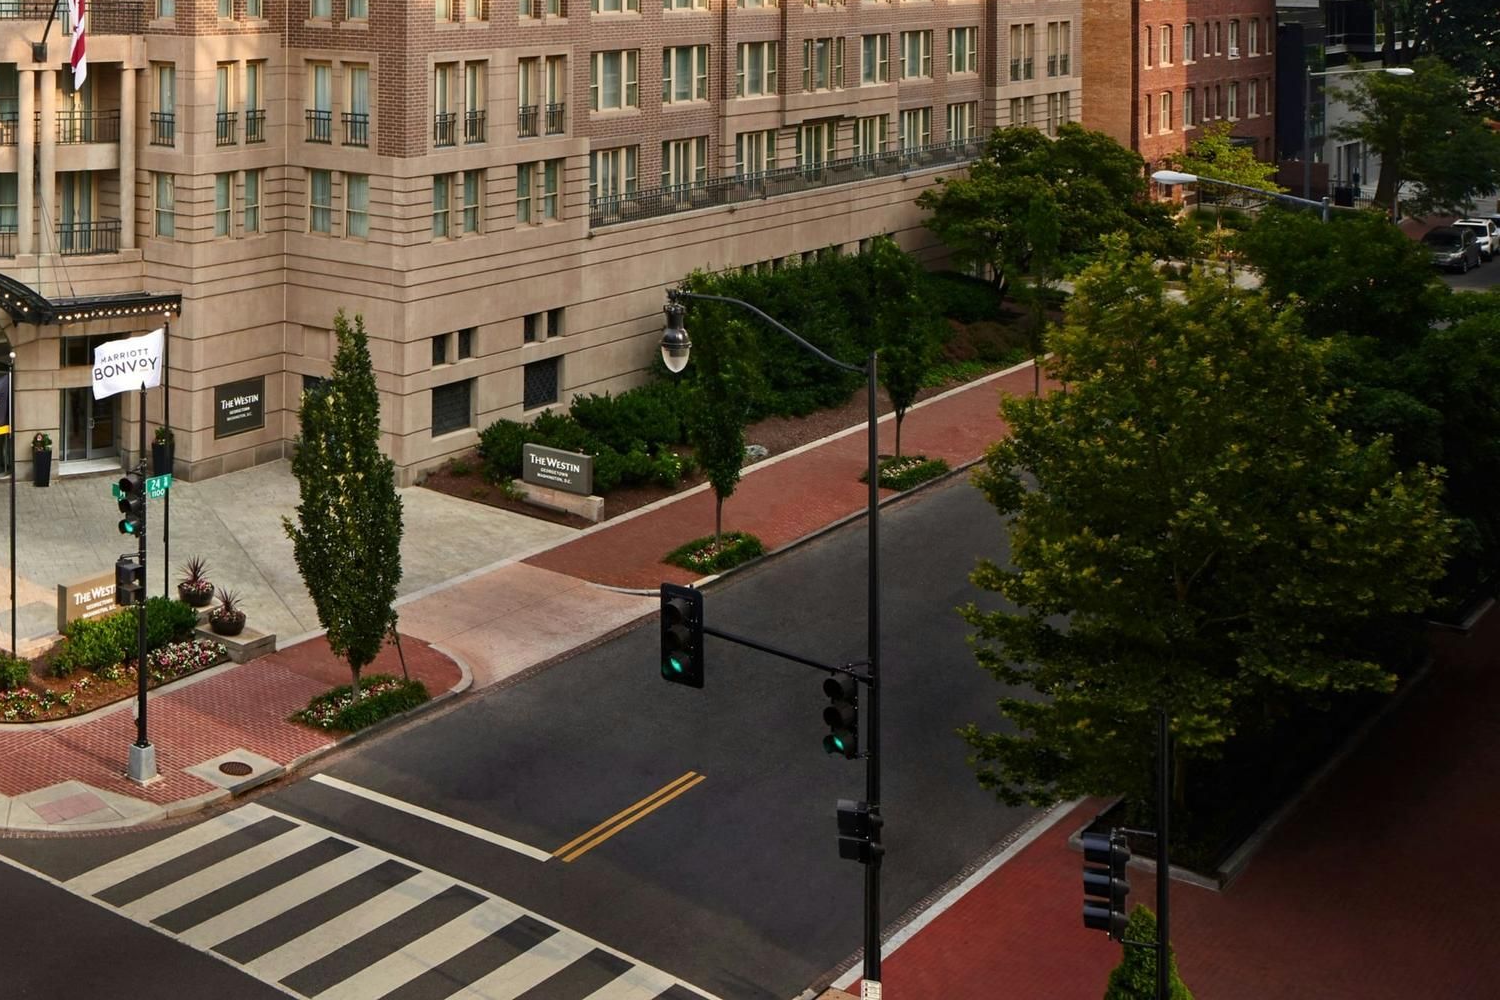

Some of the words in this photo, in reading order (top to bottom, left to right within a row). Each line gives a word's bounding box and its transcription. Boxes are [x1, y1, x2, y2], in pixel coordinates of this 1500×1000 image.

[101, 348, 148, 364] MARRIOTT
[94, 357, 157, 381] BONVOY
[233, 393, 259, 407] WESTIN
[529, 453, 546, 467] THE
[546, 456, 580, 473] WESTIN
[151, 479, 160, 490] 24
[73, 592, 91, 605] THE
